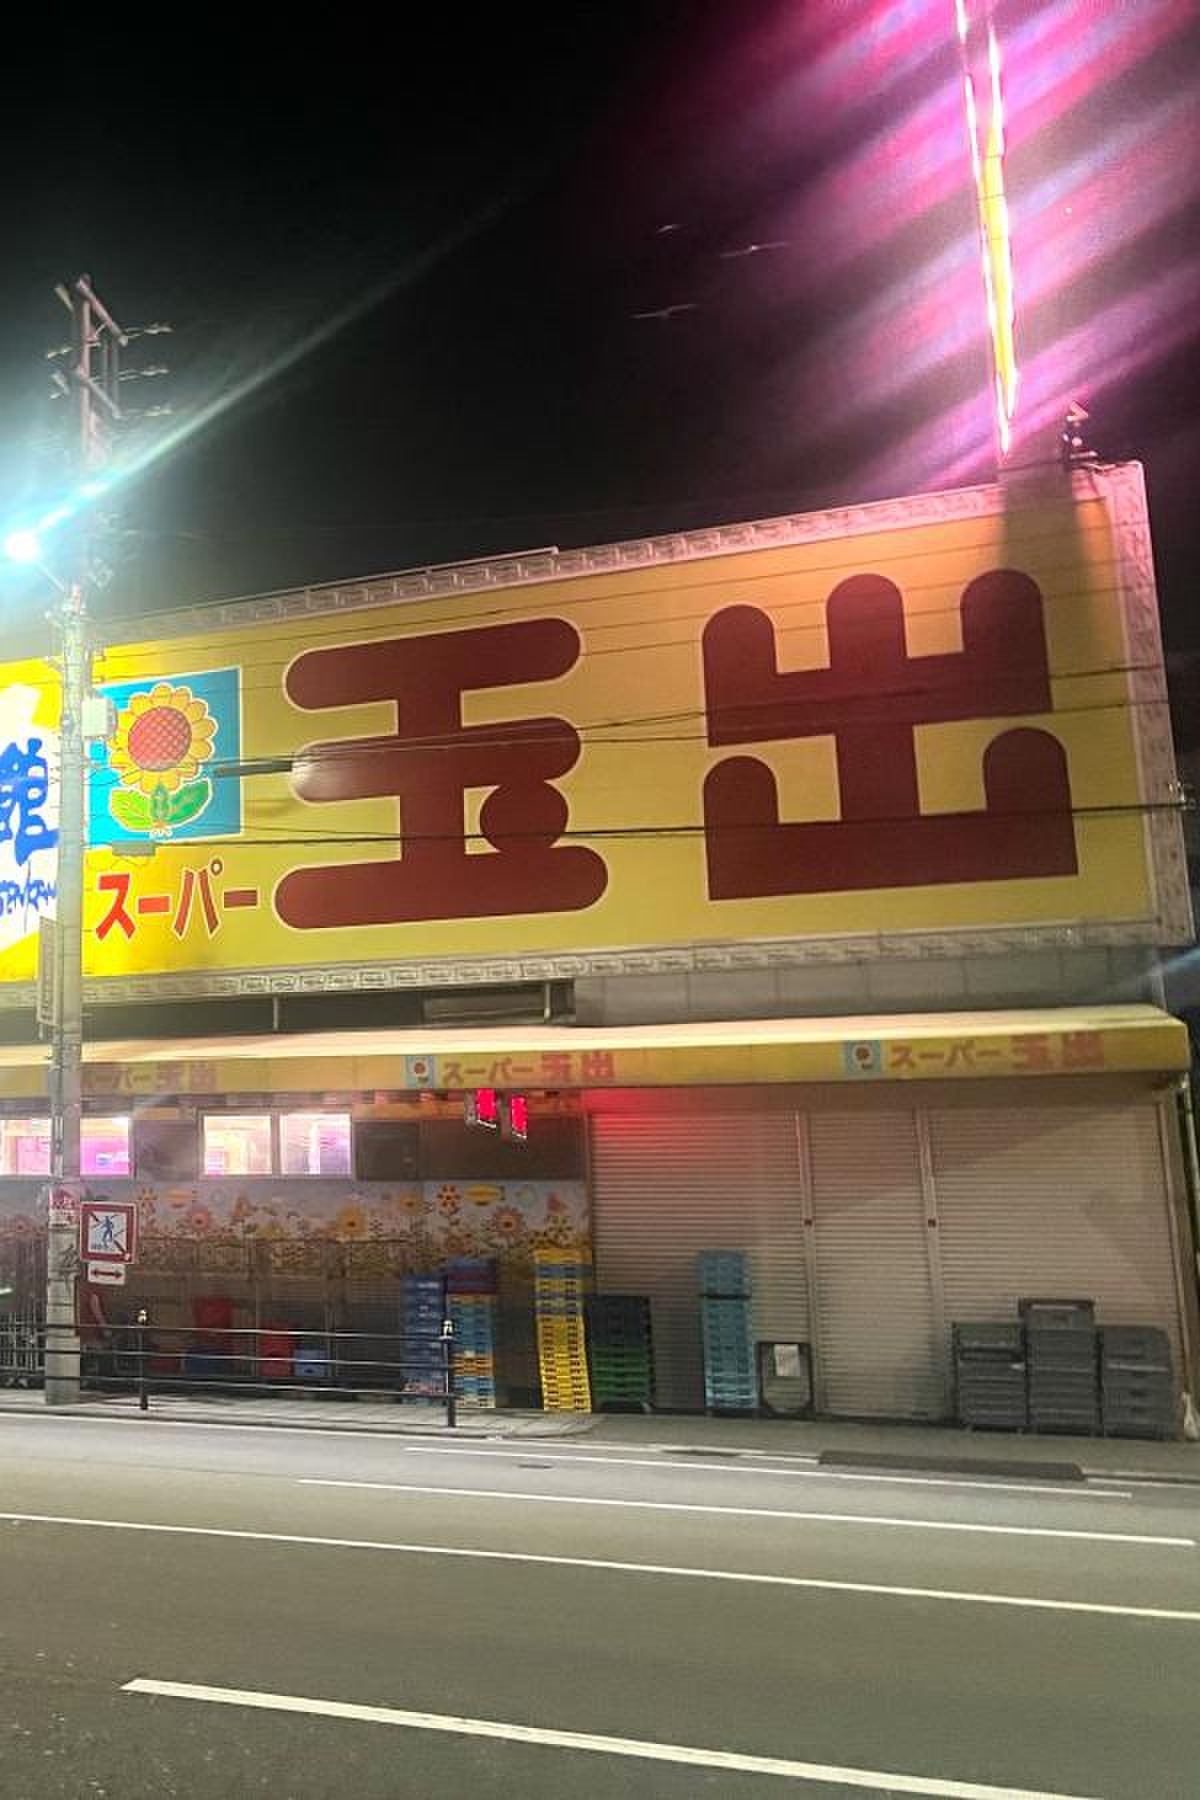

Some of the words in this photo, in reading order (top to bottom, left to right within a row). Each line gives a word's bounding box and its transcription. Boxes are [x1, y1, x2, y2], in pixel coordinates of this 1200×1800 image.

[95, 858, 260, 941] スーパー
[273, 568, 1080, 932] 玉出
